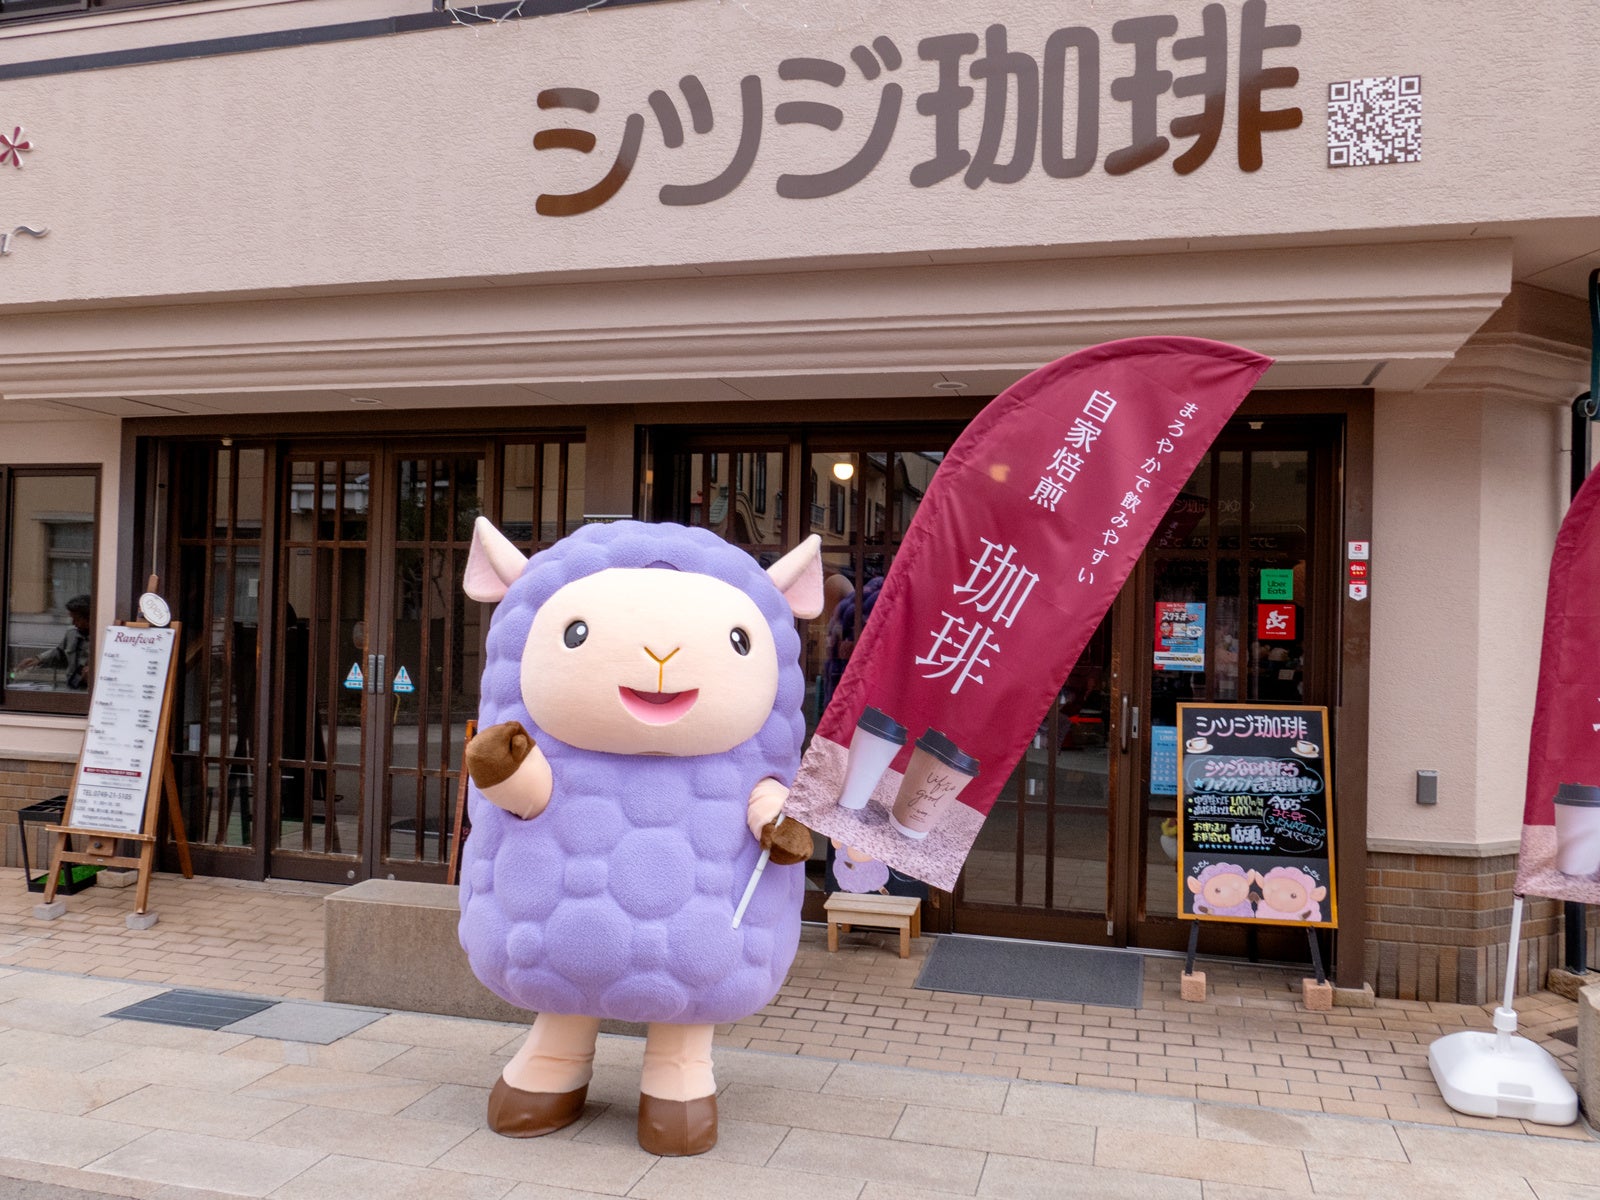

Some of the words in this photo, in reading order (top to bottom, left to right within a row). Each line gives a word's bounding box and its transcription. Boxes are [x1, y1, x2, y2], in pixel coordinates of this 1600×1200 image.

[533, 0, 1303, 217] シツジ珈琲
[1029, 389, 1118, 512] 自家焙煎
[1078, 402, 1199, 585] まろやかで飲みやすい
[915, 536, 1040, 695] 珈琲
[1196, 714, 1308, 739] シツジ珈琲
